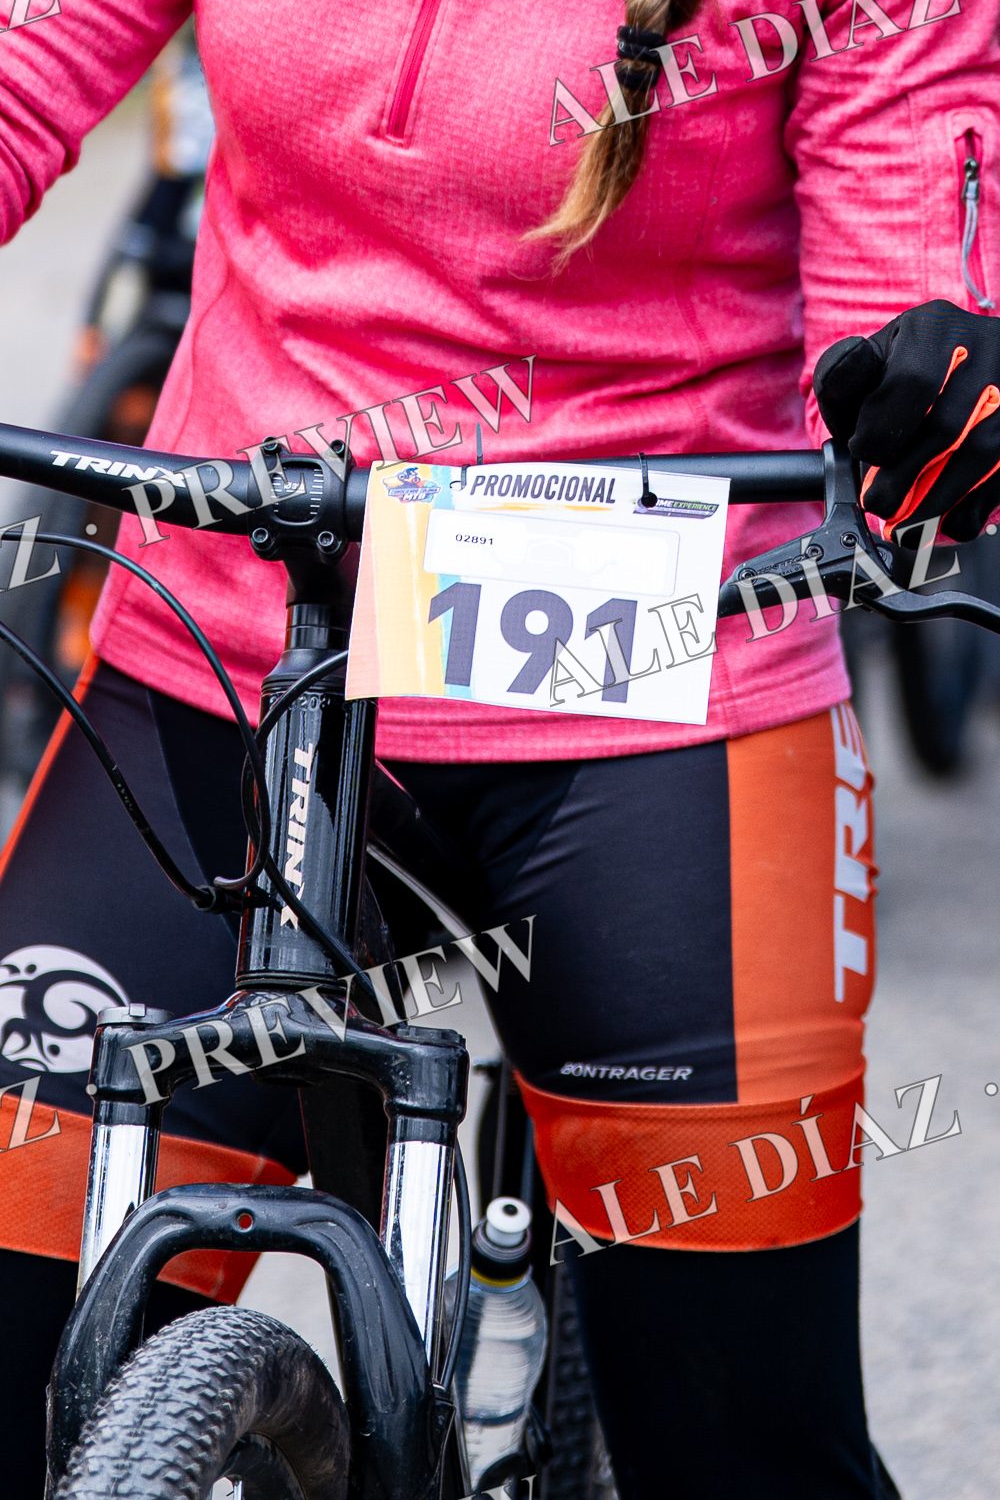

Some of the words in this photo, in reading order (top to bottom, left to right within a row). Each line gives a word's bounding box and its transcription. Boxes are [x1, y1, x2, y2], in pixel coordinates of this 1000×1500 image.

[50, 450, 190, 488] TRINX
[470, 473, 616, 504] PROMOCIONAL
[455, 533, 494, 545] 02891
[428, 582, 638, 703] 191
[560, 1062, 693, 1080] BONTRAGER
